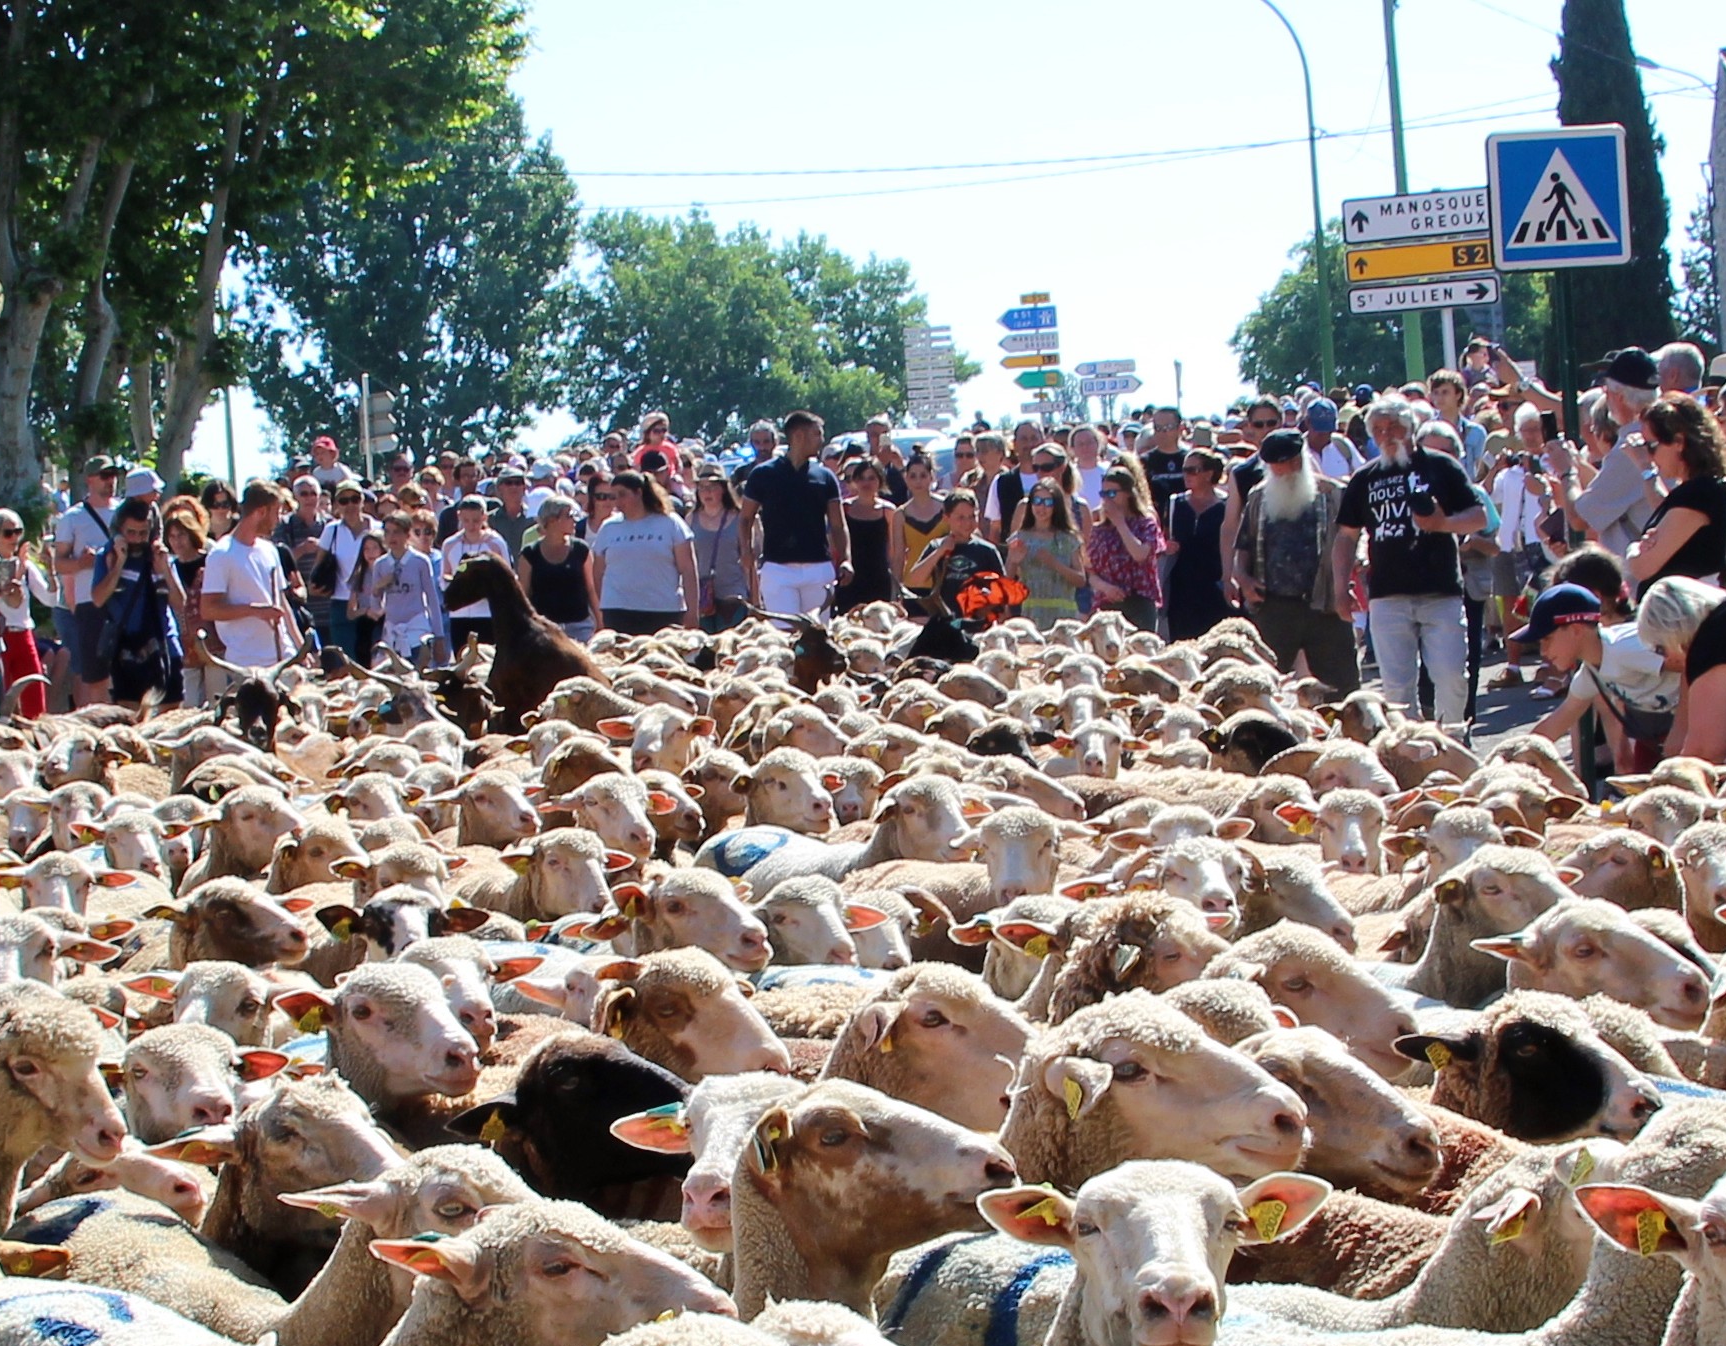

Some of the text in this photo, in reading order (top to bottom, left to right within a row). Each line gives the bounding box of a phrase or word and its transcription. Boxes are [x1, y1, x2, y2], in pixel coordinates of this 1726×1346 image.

[1380, 193, 1485, 216] MANOSQUE
[1411, 211, 1486, 230] GREOUX
[1385, 287, 1453, 306] JULIEN
